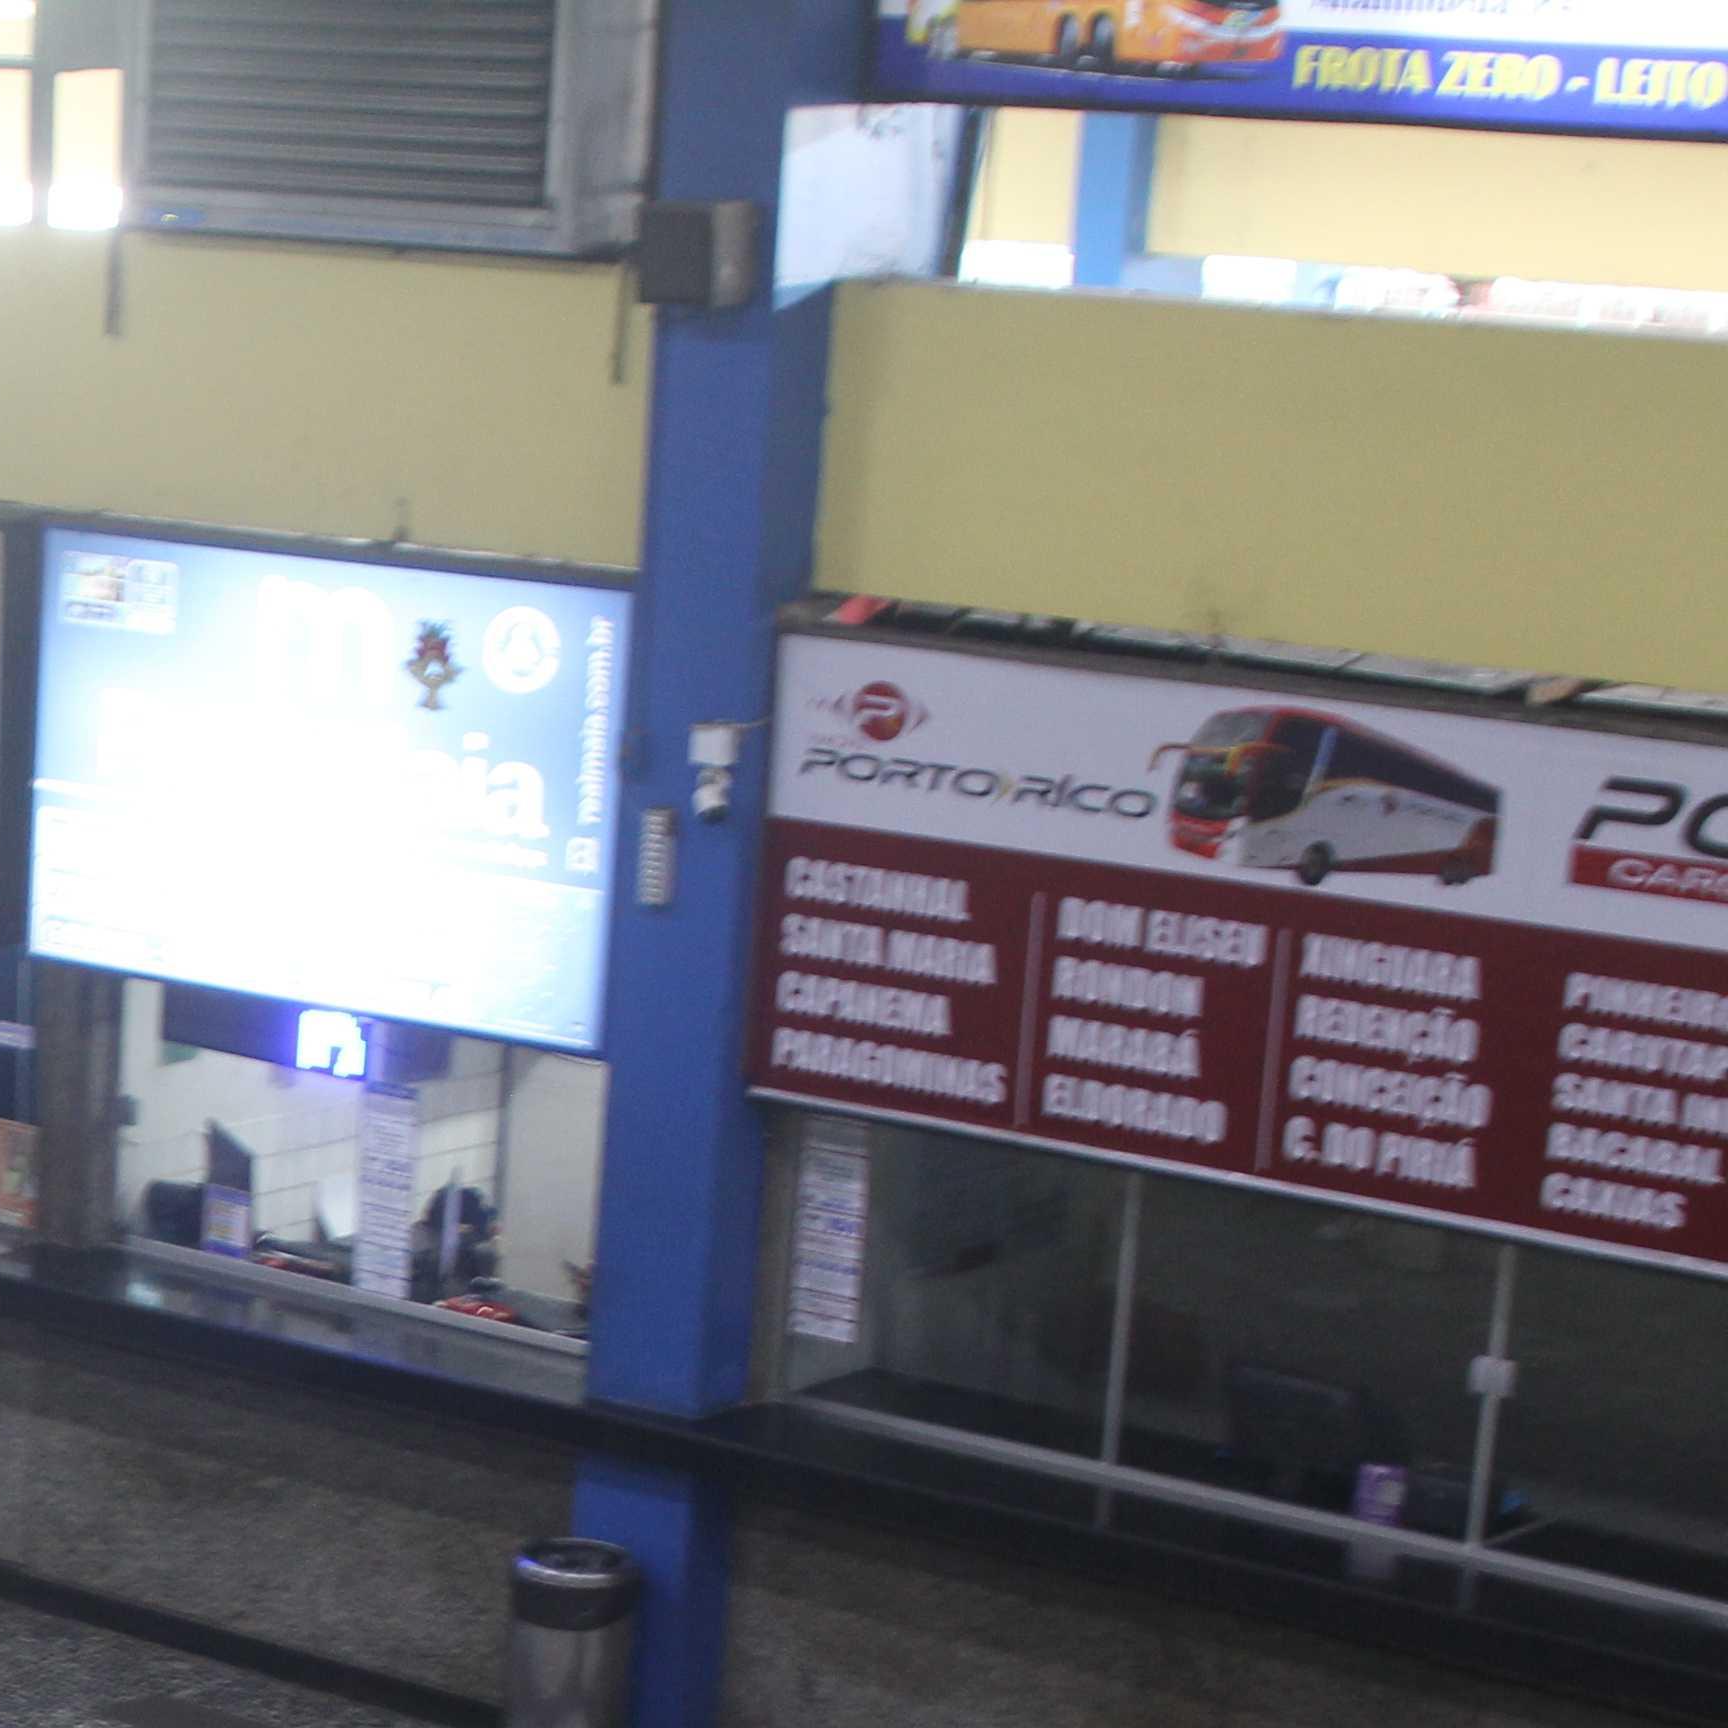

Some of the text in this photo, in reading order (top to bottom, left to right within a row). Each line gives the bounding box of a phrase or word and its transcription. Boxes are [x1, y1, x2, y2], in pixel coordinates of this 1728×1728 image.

[1292, 44, 1432, 95] FROTA
[1435, 50, 1562, 100] ZERO
[800, 747, 1000, 797] PORTO
[784, 855, 972, 923] CASTANHAL
[780, 912, 998, 986] SANTA MARIA
[1055, 895, 1269, 968] DOM ELISEU
[1299, 931, 1482, 1001] XINGUARA
[774, 969, 953, 1038] CAPANEMA
[1051, 954, 1205, 1019] RONDON
[1046, 1013, 1202, 1079] MARABÁ
[1293, 992, 1481, 1065] REDENÇÃO
[770, 1026, 1008, 1106] PARAGOMINAS
[1288, 1054, 1494, 1131] CONCEIÇÃO
[1551, 1072, 1677, 1125] SANTA
[1042, 1072, 1229, 1145] ELDORADO
